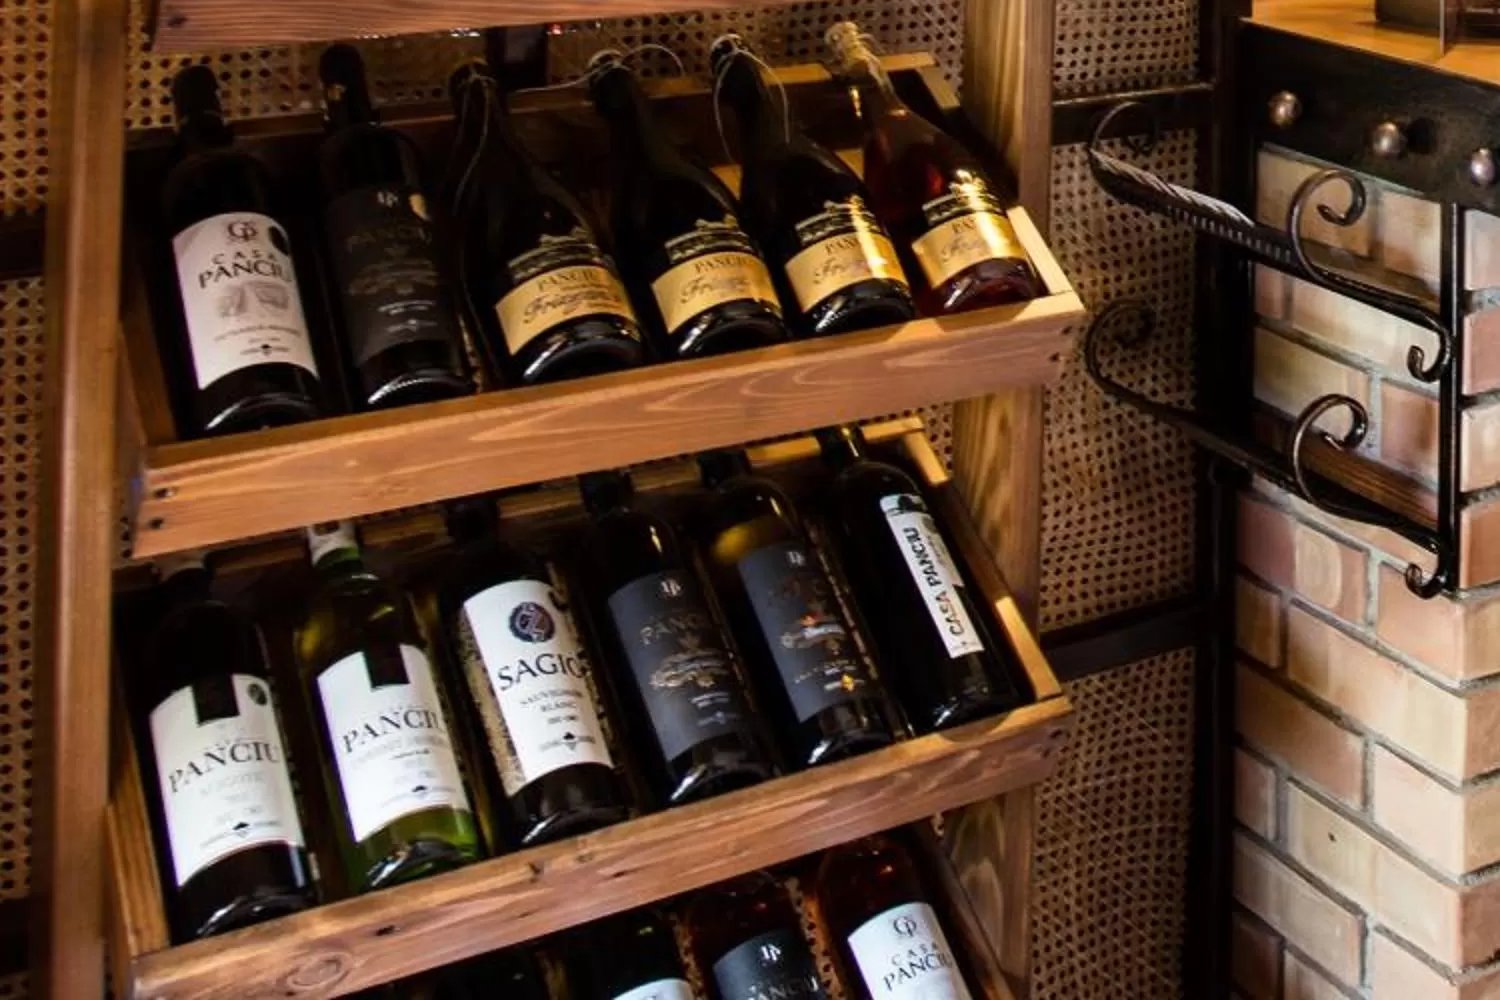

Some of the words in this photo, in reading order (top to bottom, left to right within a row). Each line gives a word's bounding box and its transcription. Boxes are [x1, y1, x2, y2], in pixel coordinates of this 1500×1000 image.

[198, 260, 292, 289] PANCIU
[212, 249, 278, 264] CASA
[903, 527, 943, 588] PANCIU
[935, 589, 965, 637] CASA
[168, 741, 281, 793] PANCIU
[883, 953, 953, 991] PANCIU
